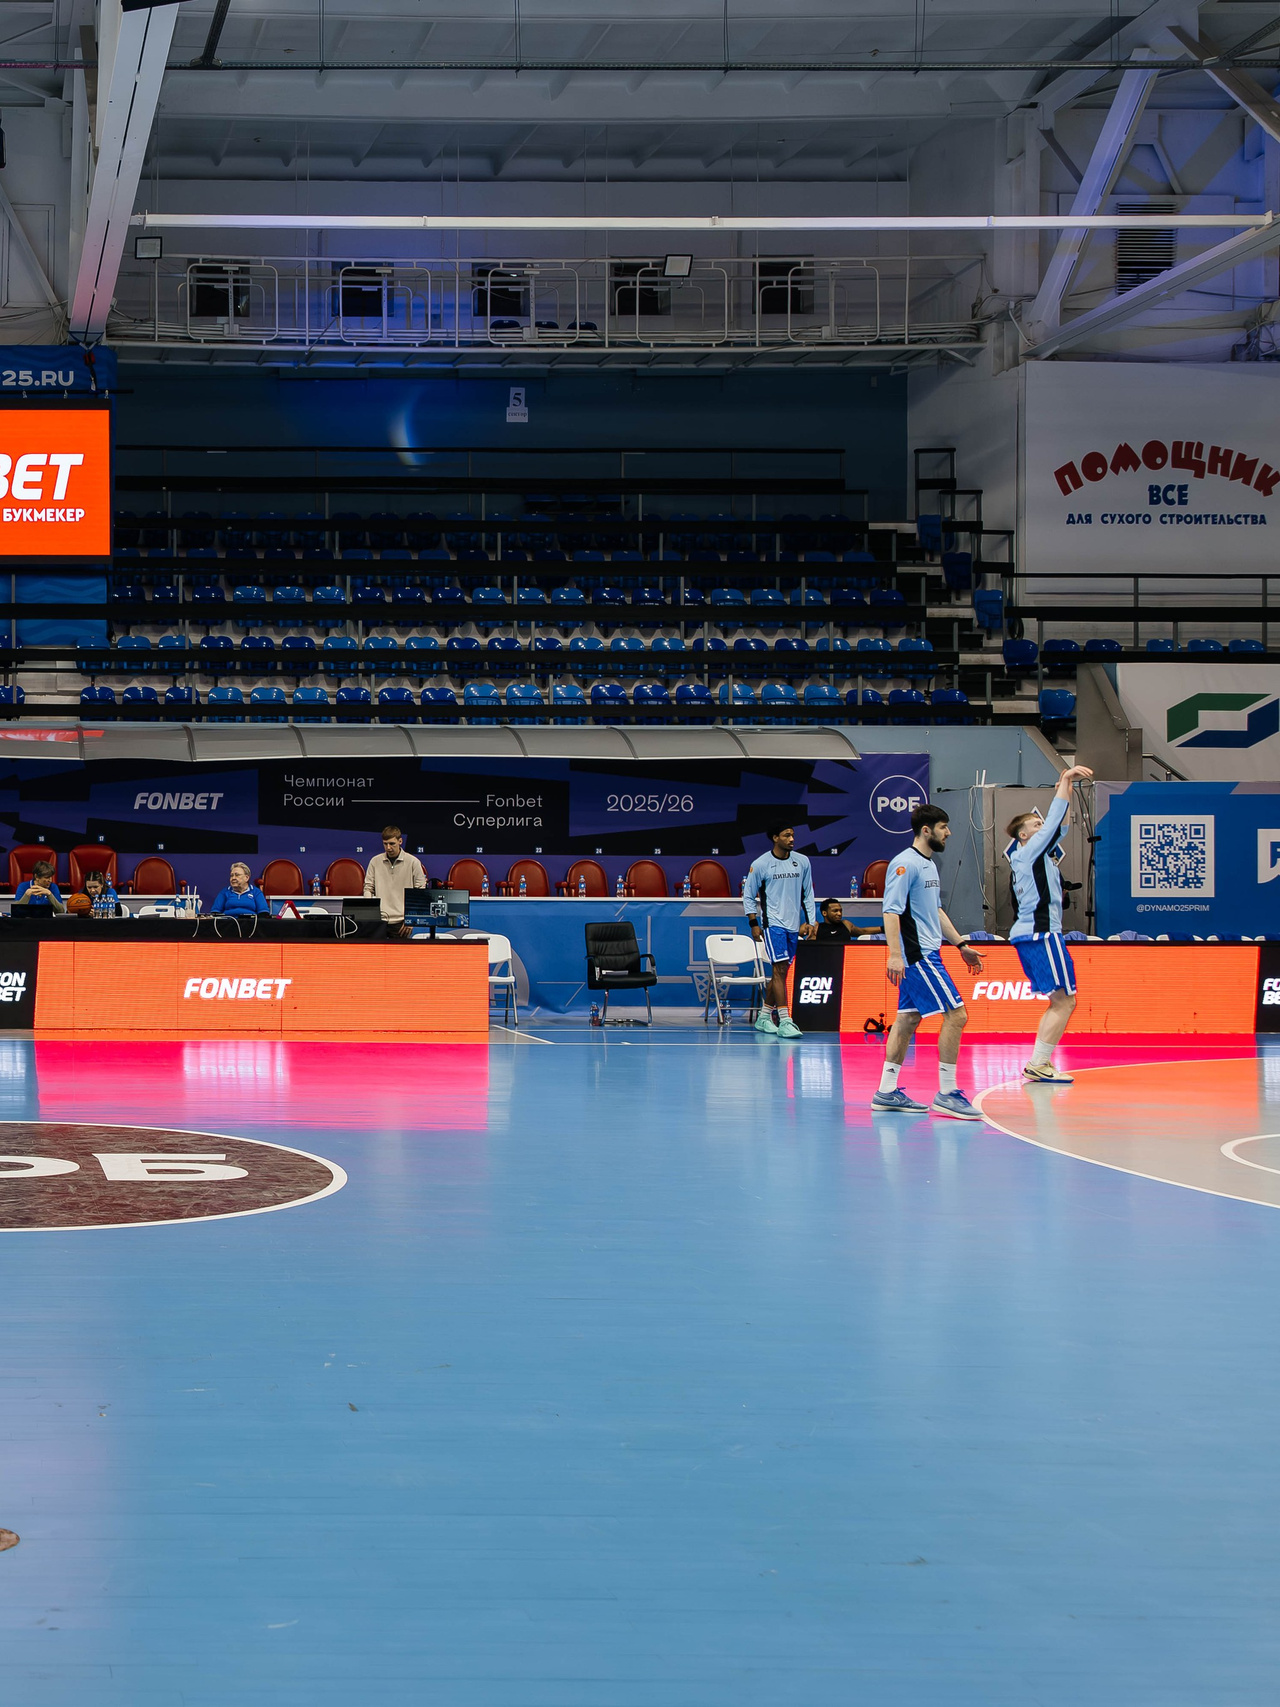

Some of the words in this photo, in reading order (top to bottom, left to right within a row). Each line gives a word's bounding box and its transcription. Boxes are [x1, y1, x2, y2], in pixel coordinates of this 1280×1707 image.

[512, 392, 522, 407] 5
[1053, 439, 1280, 497] ПОМОЩНИК
[1148, 484, 1189, 506] ВСЕ
[2, 507, 85, 522] БУКМЕКЕР
[1066, 513, 1092, 525] ДЛЯ
[1101, 513, 1152, 525] СУХОГО
[1159, 513, 1267, 525] СТРОИТЕЛЬСТВА
[284, 774, 374, 788] Чемпионат
[134, 792, 224, 810] FONBET
[283, 793, 344, 807] России
[486, 794, 543, 807] Fonbet
[607, 794, 694, 813] 2025/26
[877, 796, 921, 813] РФБ
[453, 813, 543, 829] Суперлига
[1136, 903, 1210, 912] @DYNAMO25PRIM
[184, 978, 292, 999] FONBET
[800, 977, 833, 990] FON
[972, 981, 1051, 1000] FONB
[799, 990, 832, 1004] BET
